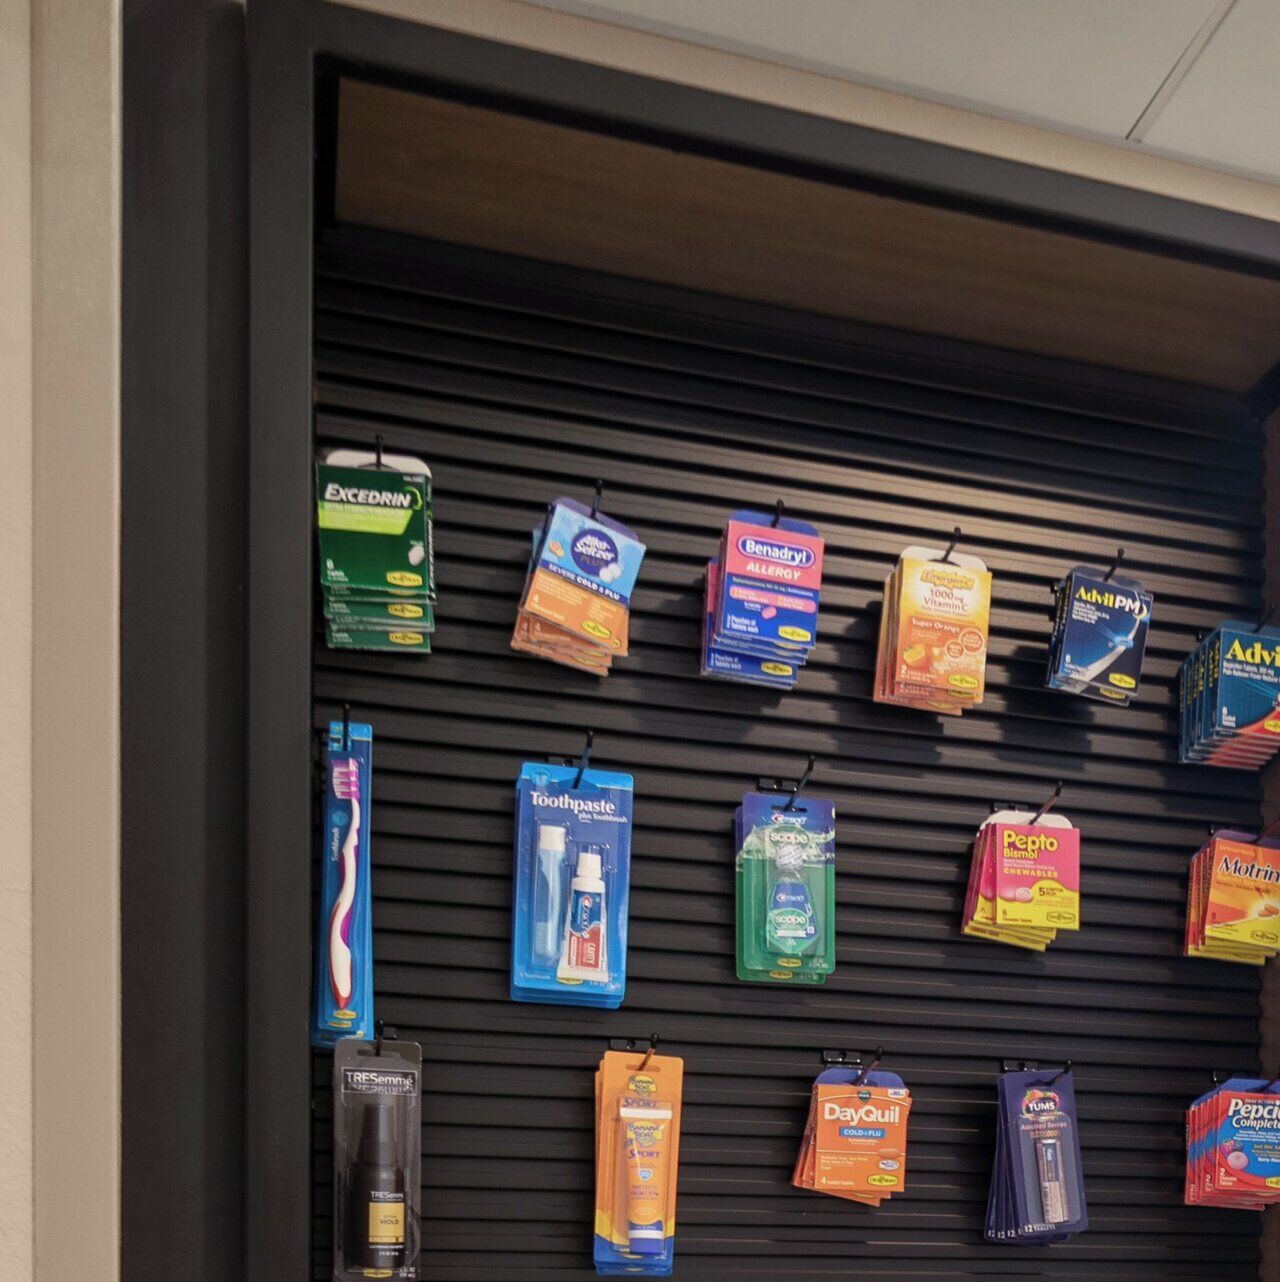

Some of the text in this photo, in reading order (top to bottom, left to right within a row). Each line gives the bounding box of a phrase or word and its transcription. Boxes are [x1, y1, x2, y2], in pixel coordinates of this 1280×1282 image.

[324, 482, 412, 508] EXCEDRIN
[574, 541, 616, 562] Seltzer
[745, 540, 807, 566] Benadryl
[746, 561, 801, 581] ALLERGY
[549, 563, 621, 601] SEVERE COLD FLU
[929, 588, 954, 600] 1000
[1075, 586, 1115, 608] Advil
[1114, 595, 1142, 616] PM
[923, 596, 961, 611] Vitamin
[530, 790, 616, 816] Toothpaste
[592, 813, 628, 824] Toothbrush
[769, 831, 810, 846] scope
[1002, 829, 1060, 852] Pepto
[1003, 848, 1038, 860] Bismol
[1003, 867, 1059, 878] CHEWABLES
[1219, 857, 1280, 884] Motrin
[1038, 887, 1046, 897] 5
[774, 913, 807, 926] scope
[345, 1070, 414, 1088] TRESemmé
[1028, 1100, 1057, 1112] TUMS
[823, 1102, 900, 1127] DayQuil
[843, 1129, 882, 1138] COLD FLU
[628, 1149, 661, 1160] SPORT
[1024, 1223, 1034, 1233] 12
